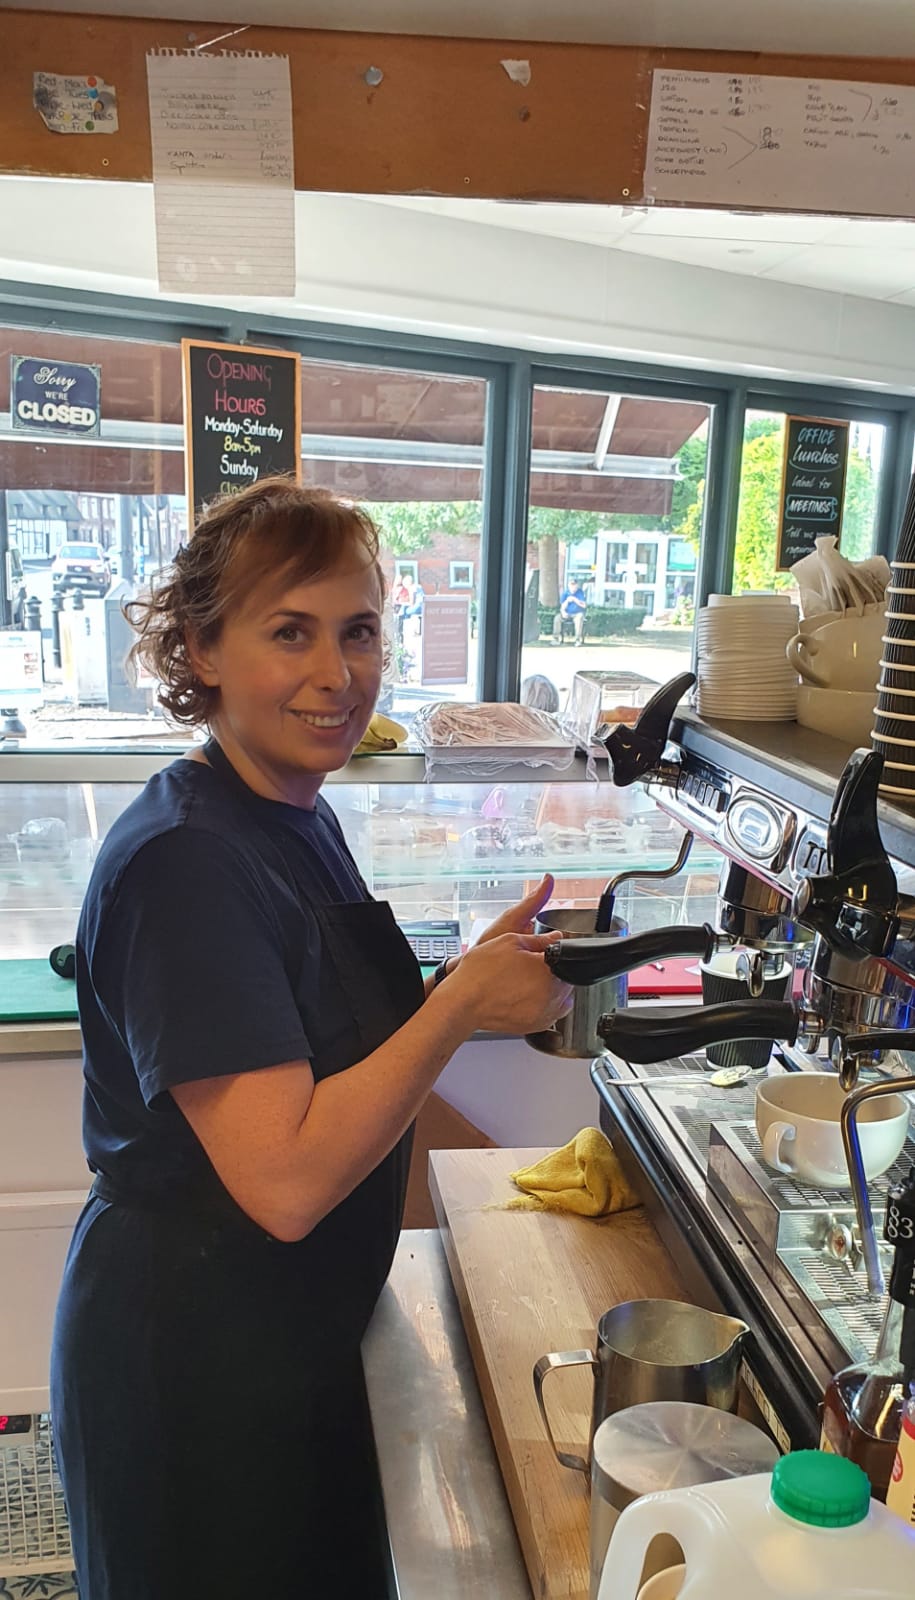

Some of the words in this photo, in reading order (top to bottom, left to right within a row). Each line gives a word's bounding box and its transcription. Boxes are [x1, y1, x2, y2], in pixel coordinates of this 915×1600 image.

[33, 366, 77, 392] Sorry
[206, 352, 273, 391] OPENING
[44, 390, 69, 401] WE'RE
[215, 389, 267, 416] HOURS
[17, 399, 97, 427] CLOSED
[797, 426, 836, 446] OFFICE
[219, 453, 259, 482] Sunday
[789, 498, 832, 514] MEETINGS
